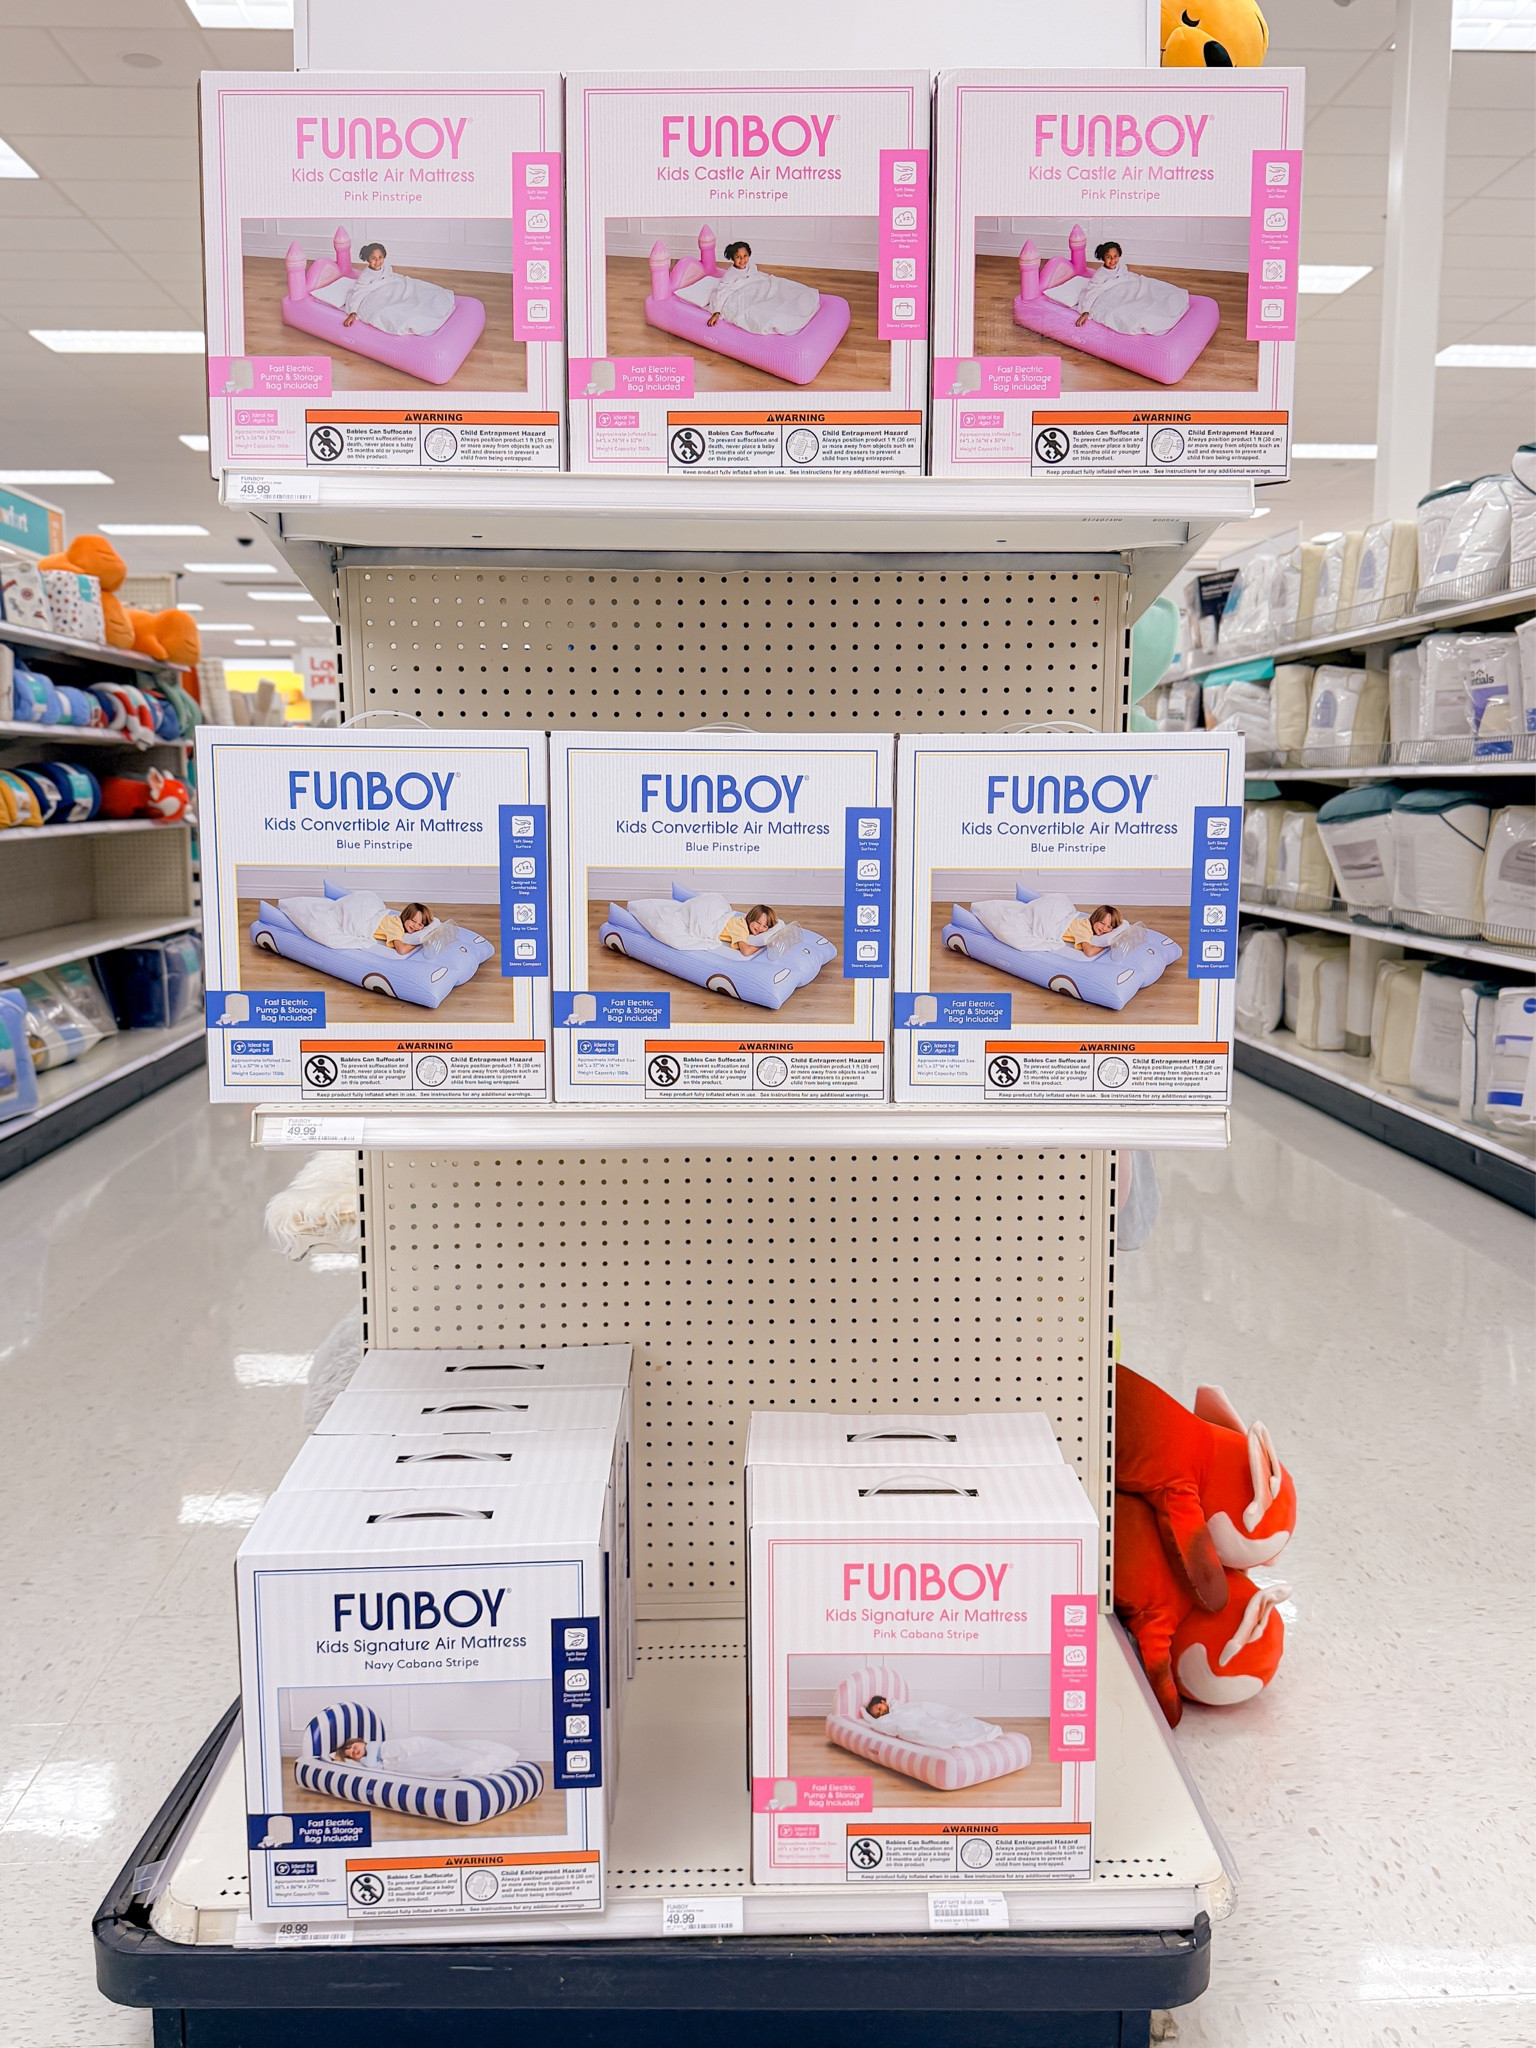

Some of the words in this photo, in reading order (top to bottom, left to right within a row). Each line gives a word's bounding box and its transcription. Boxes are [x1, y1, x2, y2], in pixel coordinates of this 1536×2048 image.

[297, 118, 467, 159] FUNBOY
[663, 115, 834, 157] FUNBOY
[1036, 115, 1208, 157] FUNBOY
[292, 168, 323, 182] Kids
[329, 168, 378, 182] Castle
[384, 168, 404, 182] Air
[410, 168, 474, 182] Mattress
[658, 167, 689, 180] Kids
[695, 166, 744, 180] Castle
[750, 166, 770, 179] Air
[776, 166, 841, 179] Mattress
[1030, 166, 1061, 180] Kids
[1067, 166, 1116, 180] Castle
[1122, 166, 1143, 180] Air
[1149, 166, 1214, 180] Mattress
[345, 191, 368, 201] Pink
[373, 191, 422, 204] Pinstripe
[710, 189, 734, 199] Pink
[738, 189, 788, 202] Pinstripe
[1082, 189, 1105, 199] Pink
[1110, 189, 1160, 202] Pinstripe
[293, 374, 322, 382] Storage
[655, 375, 685, 383] Storage
[1022, 375, 1051, 383] Storage
[266, 382, 281, 391] Bag
[628, 384, 643, 392] Bag
[994, 383, 1009, 392] Bag
[241, 485, 270, 493] 49.99
[289, 771, 454, 810] FUNBOY
[642, 774, 803, 813] FUNBOY
[988, 775, 1152, 814] FUNBOY
[265, 818, 296, 830] Kids
[301, 818, 390, 831] Convertible
[396, 819, 415, 831] Air
[421, 819, 482, 832] Mattress
[617, 820, 646, 833] Kids
[652, 821, 738, 834] Convertible
[744, 822, 763, 834] Air
[769, 822, 829, 834] Mattress
[962, 822, 992, 835] Kids
[998, 822, 1084, 834] Convertible
[1090, 822, 1109, 834] Air
[1115, 822, 1177, 834] Mattress
[337, 840, 360, 848] Blue
[364, 840, 412, 851] Pinstripe
[686, 842, 708, 851] Blue
[713, 842, 759, 854] Pinstripe
[1031, 843, 1054, 852] Blue
[1058, 843, 1105, 854] Pinstripe
[288, 1007, 317, 1015] Storage
[975, 1008, 1003, 1016] Storage
[261, 1015, 276, 1023] Bag
[949, 1016, 963, 1024] Bag
[288, 1127, 316, 1135] 49.99
[844, 1563, 1008, 1601] FUNBOY
[334, 1589, 505, 1632] FUNBOY
[826, 1609, 856, 1621] Kids
[862, 1609, 934, 1624] Signature
[940, 1609, 959, 1621] Air
[965, 1609, 1027, 1621] Mattress
[874, 1629, 896, 1638] Pink
[900, 1629, 943, 1638] Cabana
[947, 1630, 978, 1641] Stripe
[317, 1640, 348, 1653] Kids
[354, 1638, 429, 1655] Signature
[436, 1637, 456, 1650] Air
[462, 1635, 526, 1648] Mattress
[365, 1660, 393, 1672] Navy
[397, 1659, 442, 1668] Cabana
[446, 1658, 478, 1669] Stripe
[305, 1836, 321, 1844] Bag
[454, 1856, 504, 1864] WARNING
[667, 1914, 695, 1923] 49.99
[280, 1924, 308, 1934] 49.99
